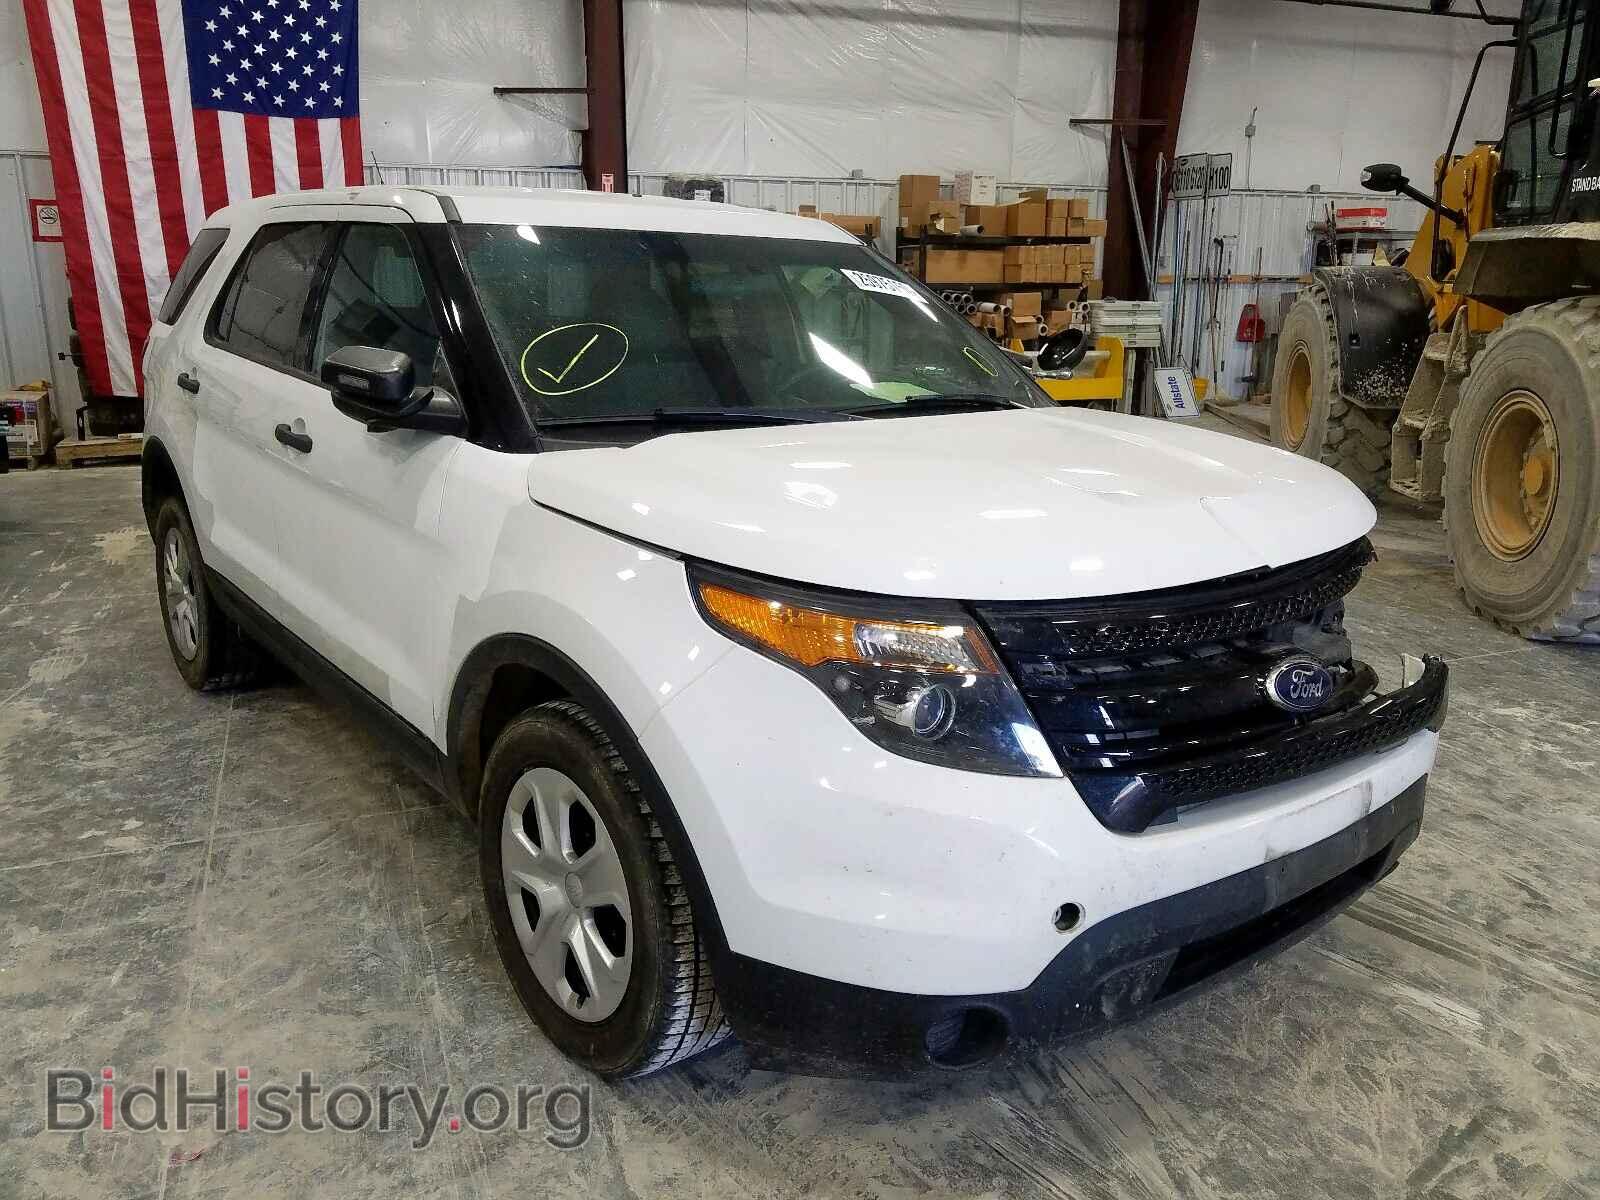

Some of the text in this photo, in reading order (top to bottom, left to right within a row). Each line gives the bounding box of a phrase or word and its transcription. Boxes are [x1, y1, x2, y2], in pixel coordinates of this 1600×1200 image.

[1209, 166, 1230, 190] H100
[1167, 376, 1185, 409] Allstate
[1290, 669, 1324, 699] Ford
